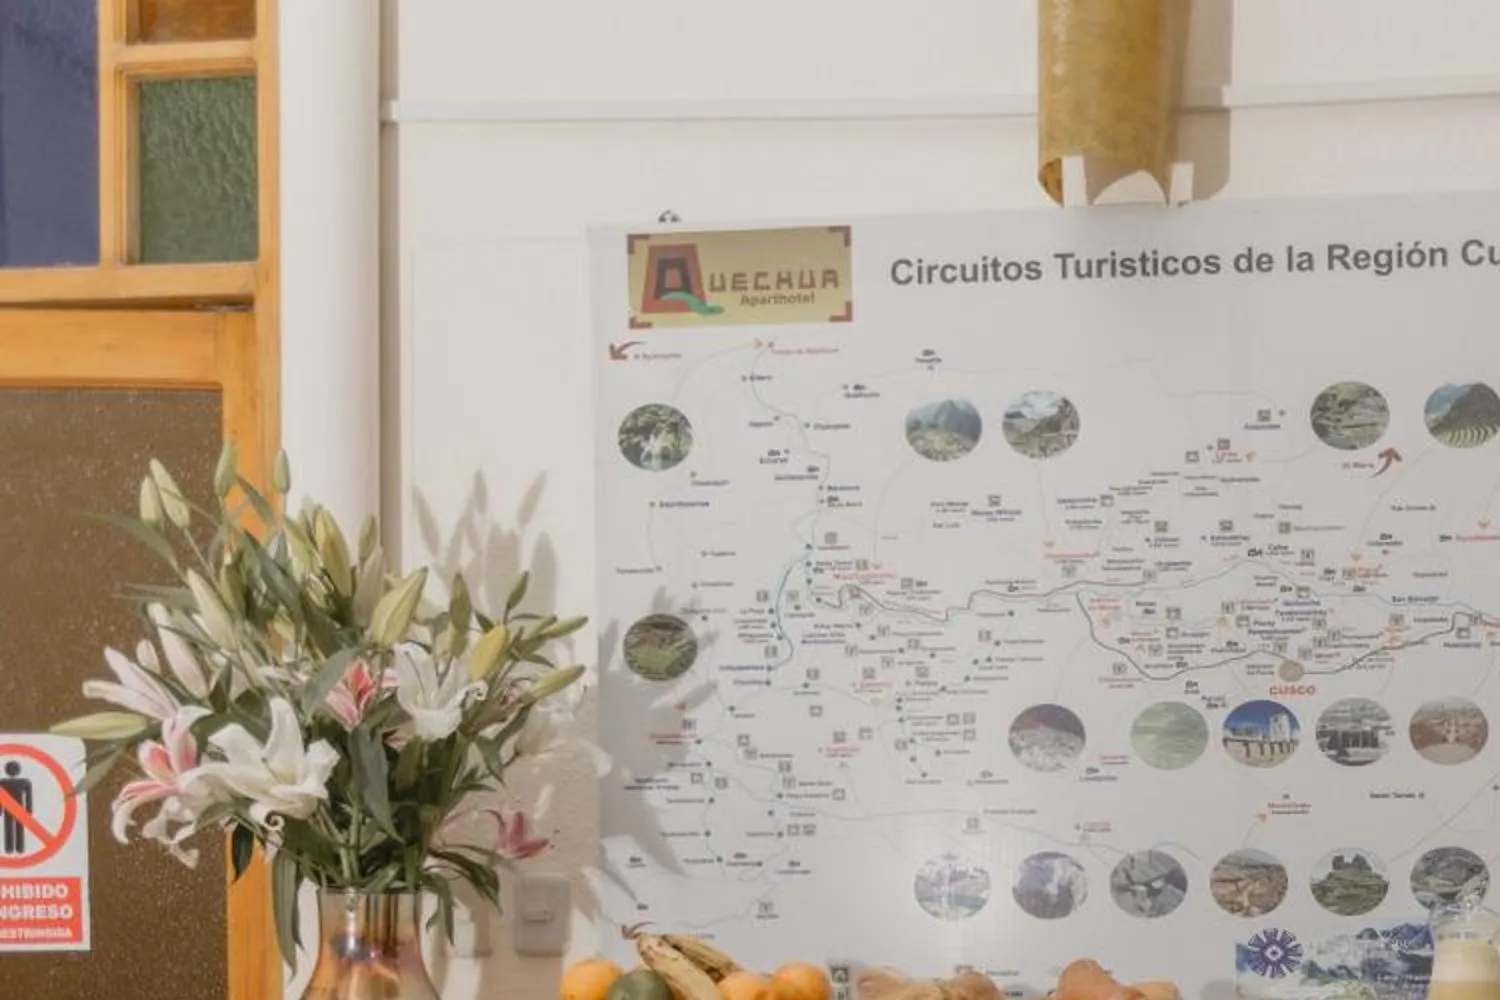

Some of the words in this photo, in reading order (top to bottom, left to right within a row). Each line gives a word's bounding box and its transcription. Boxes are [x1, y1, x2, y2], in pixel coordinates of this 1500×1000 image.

[890, 256, 1043, 285] Circuitos
[1052, 249, 1221, 280] Turisticos
[1233, 247, 1274, 273] de
[1287, 245, 1314, 272] la
[1327, 241, 1448, 276] Región
[740, 291, 816, 307] Aparthotel
[1268, 685, 1316, 696] CUSCO
